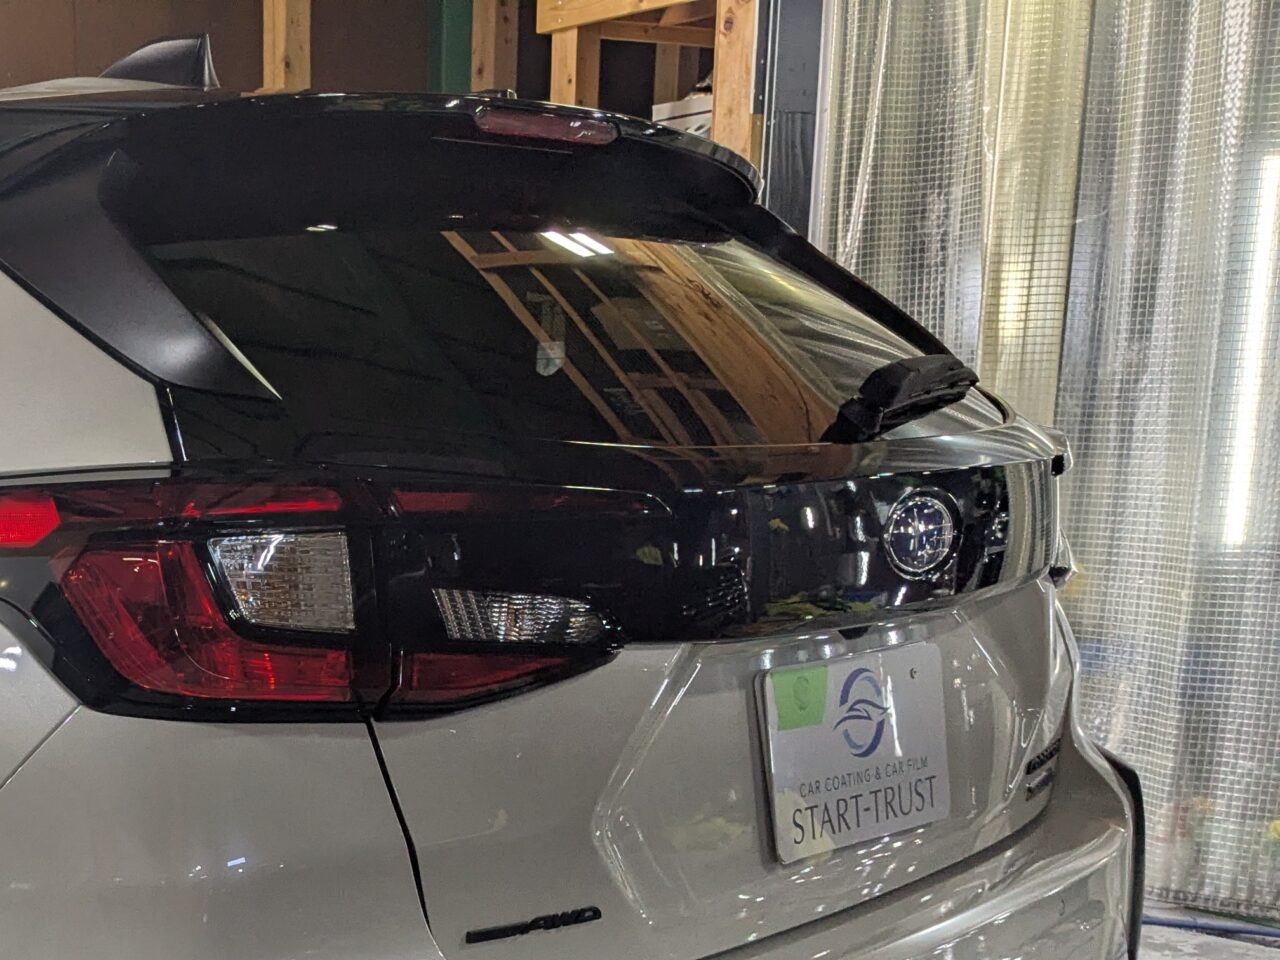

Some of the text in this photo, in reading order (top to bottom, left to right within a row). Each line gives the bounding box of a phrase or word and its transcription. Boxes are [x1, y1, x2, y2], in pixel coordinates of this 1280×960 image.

[799, 756, 929, 798] CAR COATING & CAR FILM
[792, 775, 936, 845] START-TRUST
